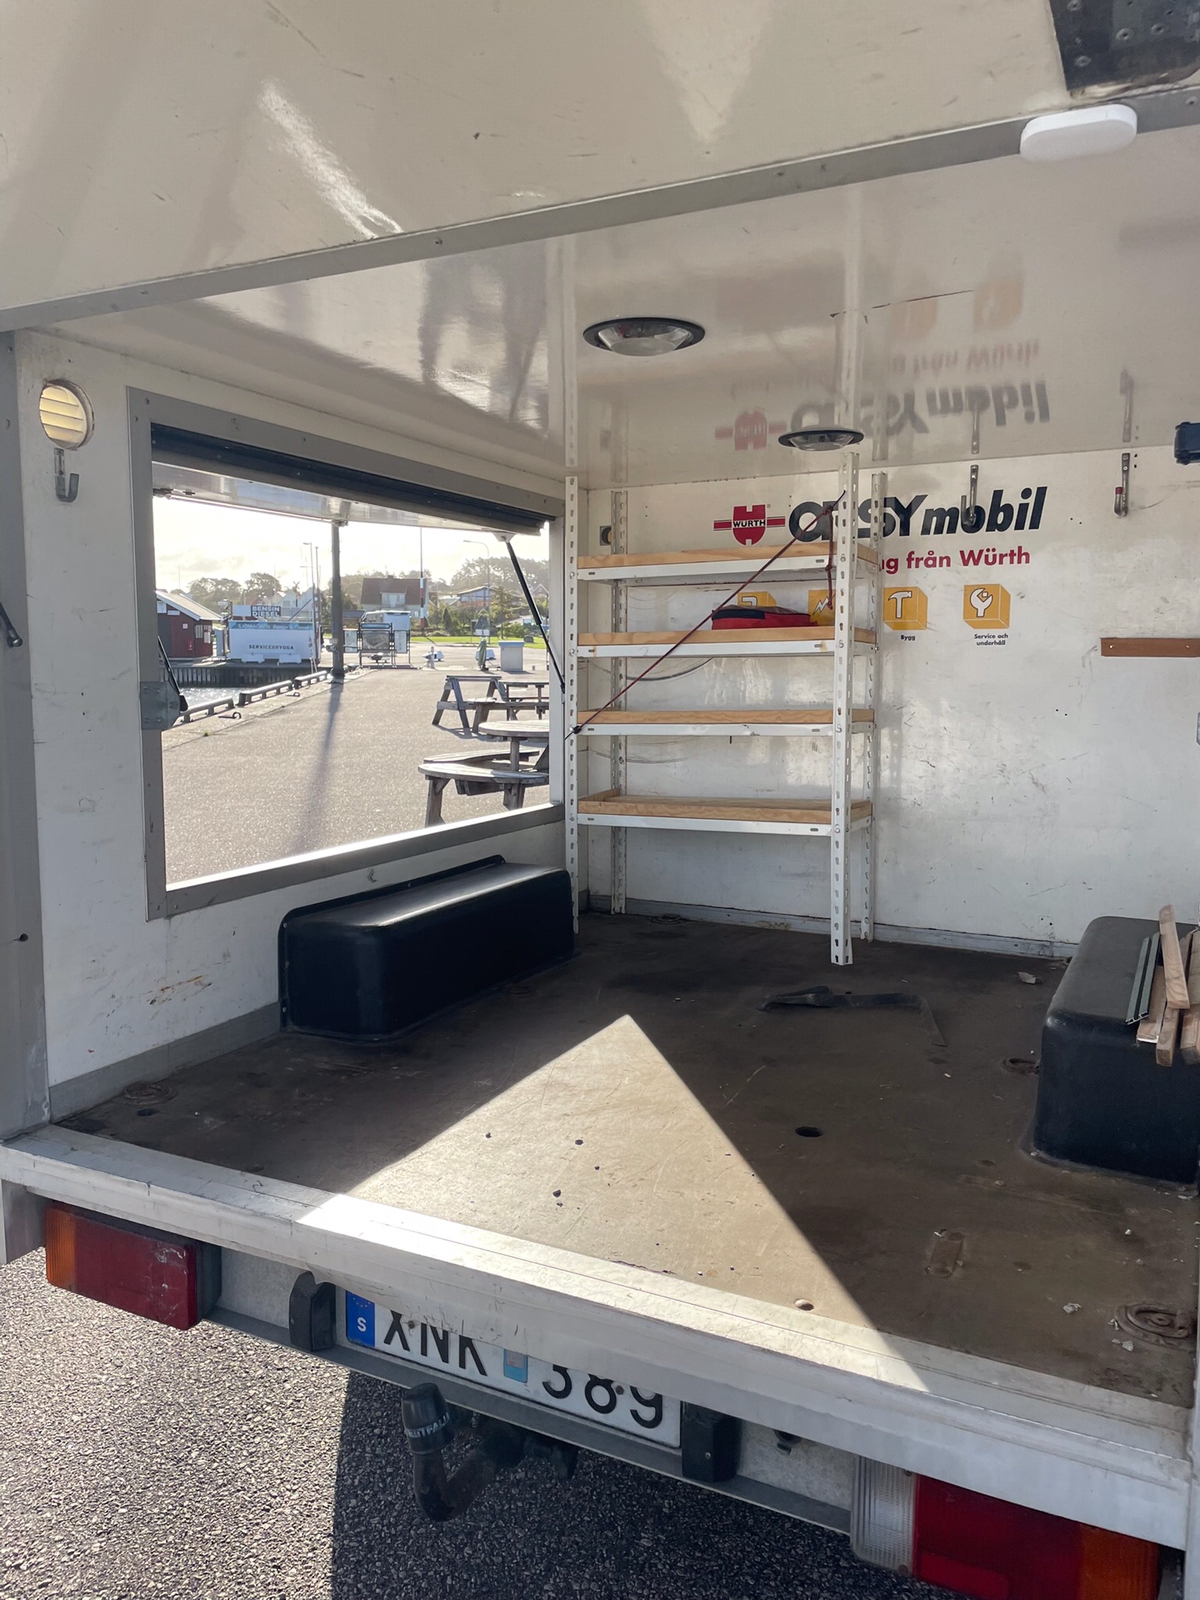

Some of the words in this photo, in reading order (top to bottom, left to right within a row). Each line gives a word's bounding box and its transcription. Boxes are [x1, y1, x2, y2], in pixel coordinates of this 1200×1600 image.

[906, 551, 951, 569] från
[959, 546, 1030, 567] Würth
[357, 1317, 367, 1332] S
